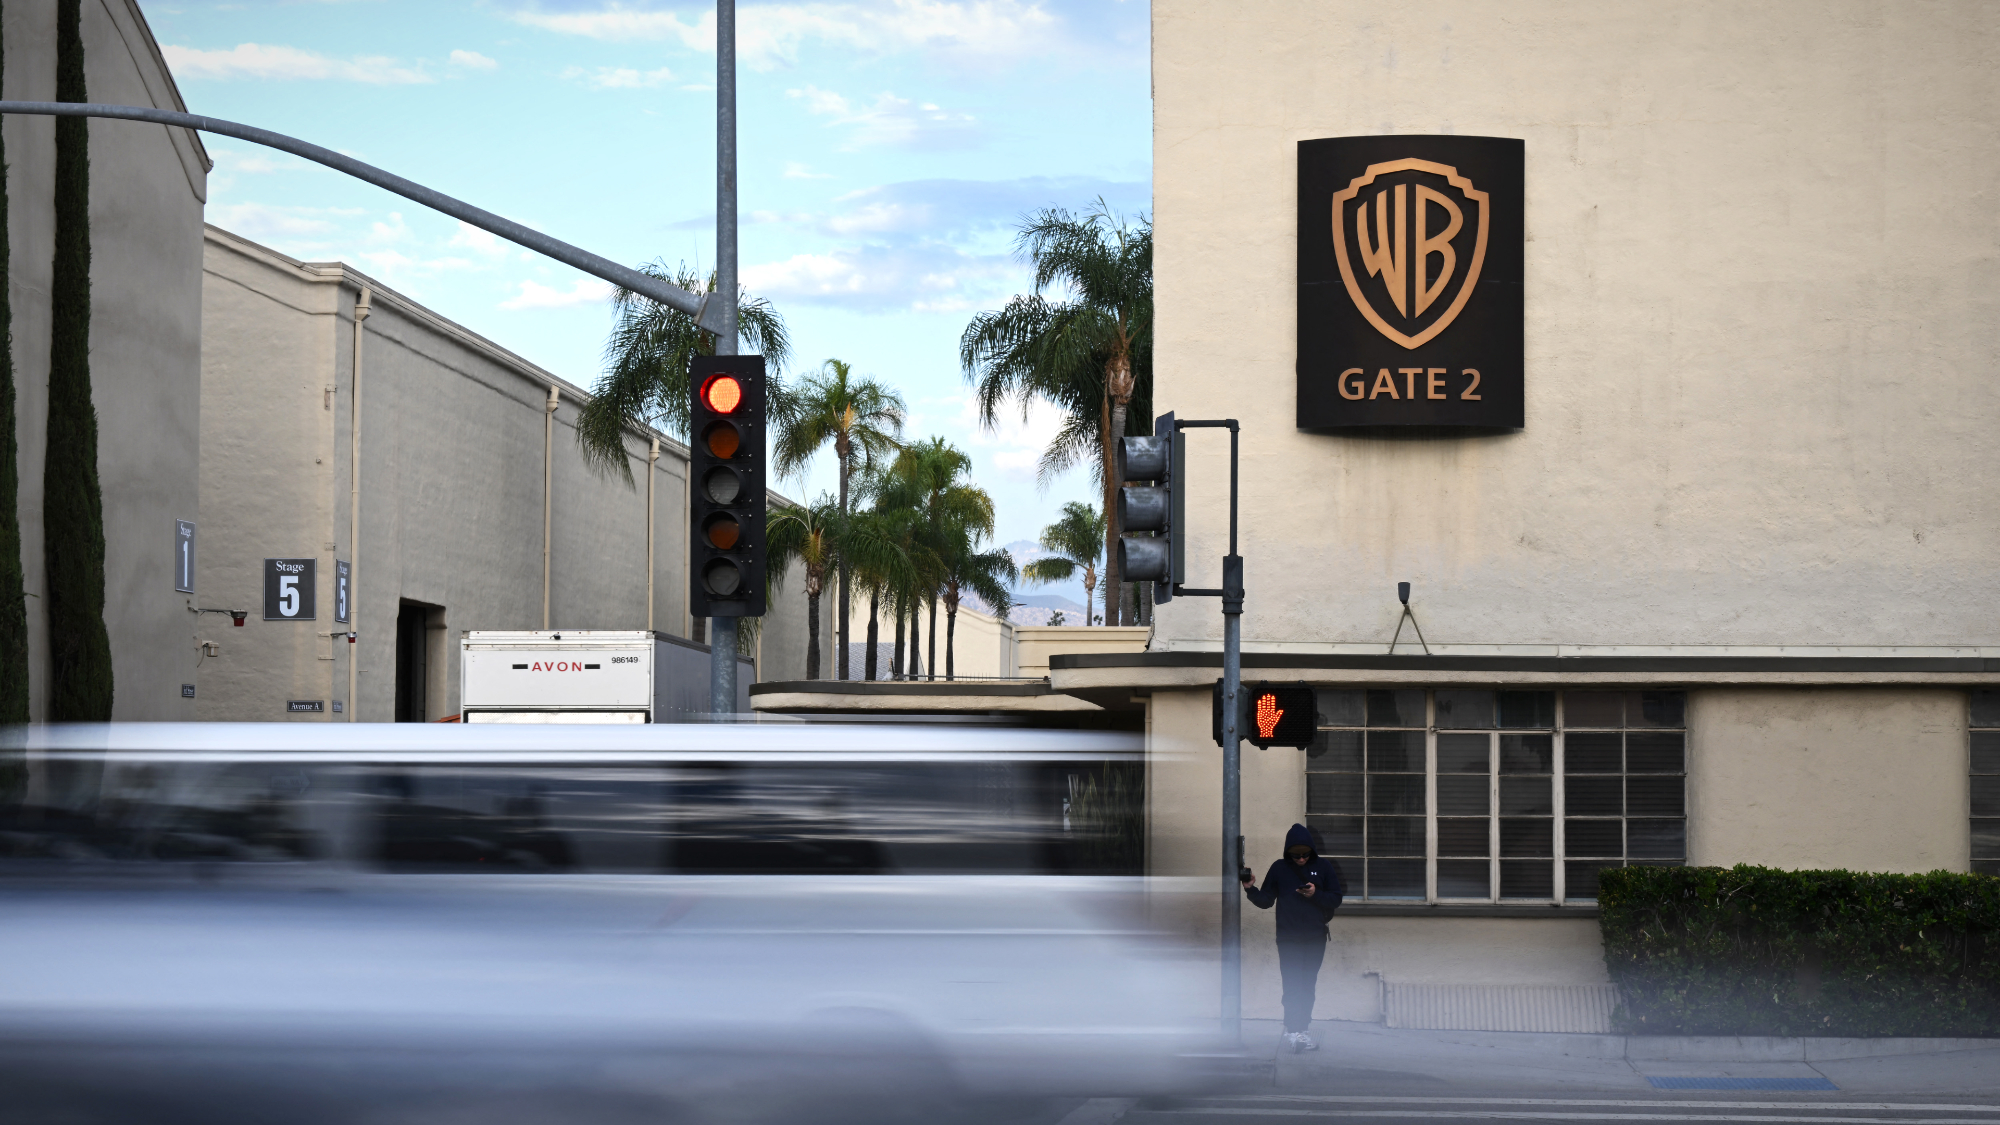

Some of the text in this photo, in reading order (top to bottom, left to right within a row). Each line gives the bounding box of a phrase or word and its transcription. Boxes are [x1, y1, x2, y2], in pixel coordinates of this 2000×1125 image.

[1357, 183, 1464, 319] WB
[1338, 367, 1482, 401] GATE 2
[183, 540, 188, 588] 1
[276, 560, 304, 574] Stage
[279, 575, 300, 617] 5
[340, 577, 346, 618] 5
[531, 661, 582, 672] AVON
[611, 656, 639, 664] 986149
[291, 702, 320, 710] Avenue A
